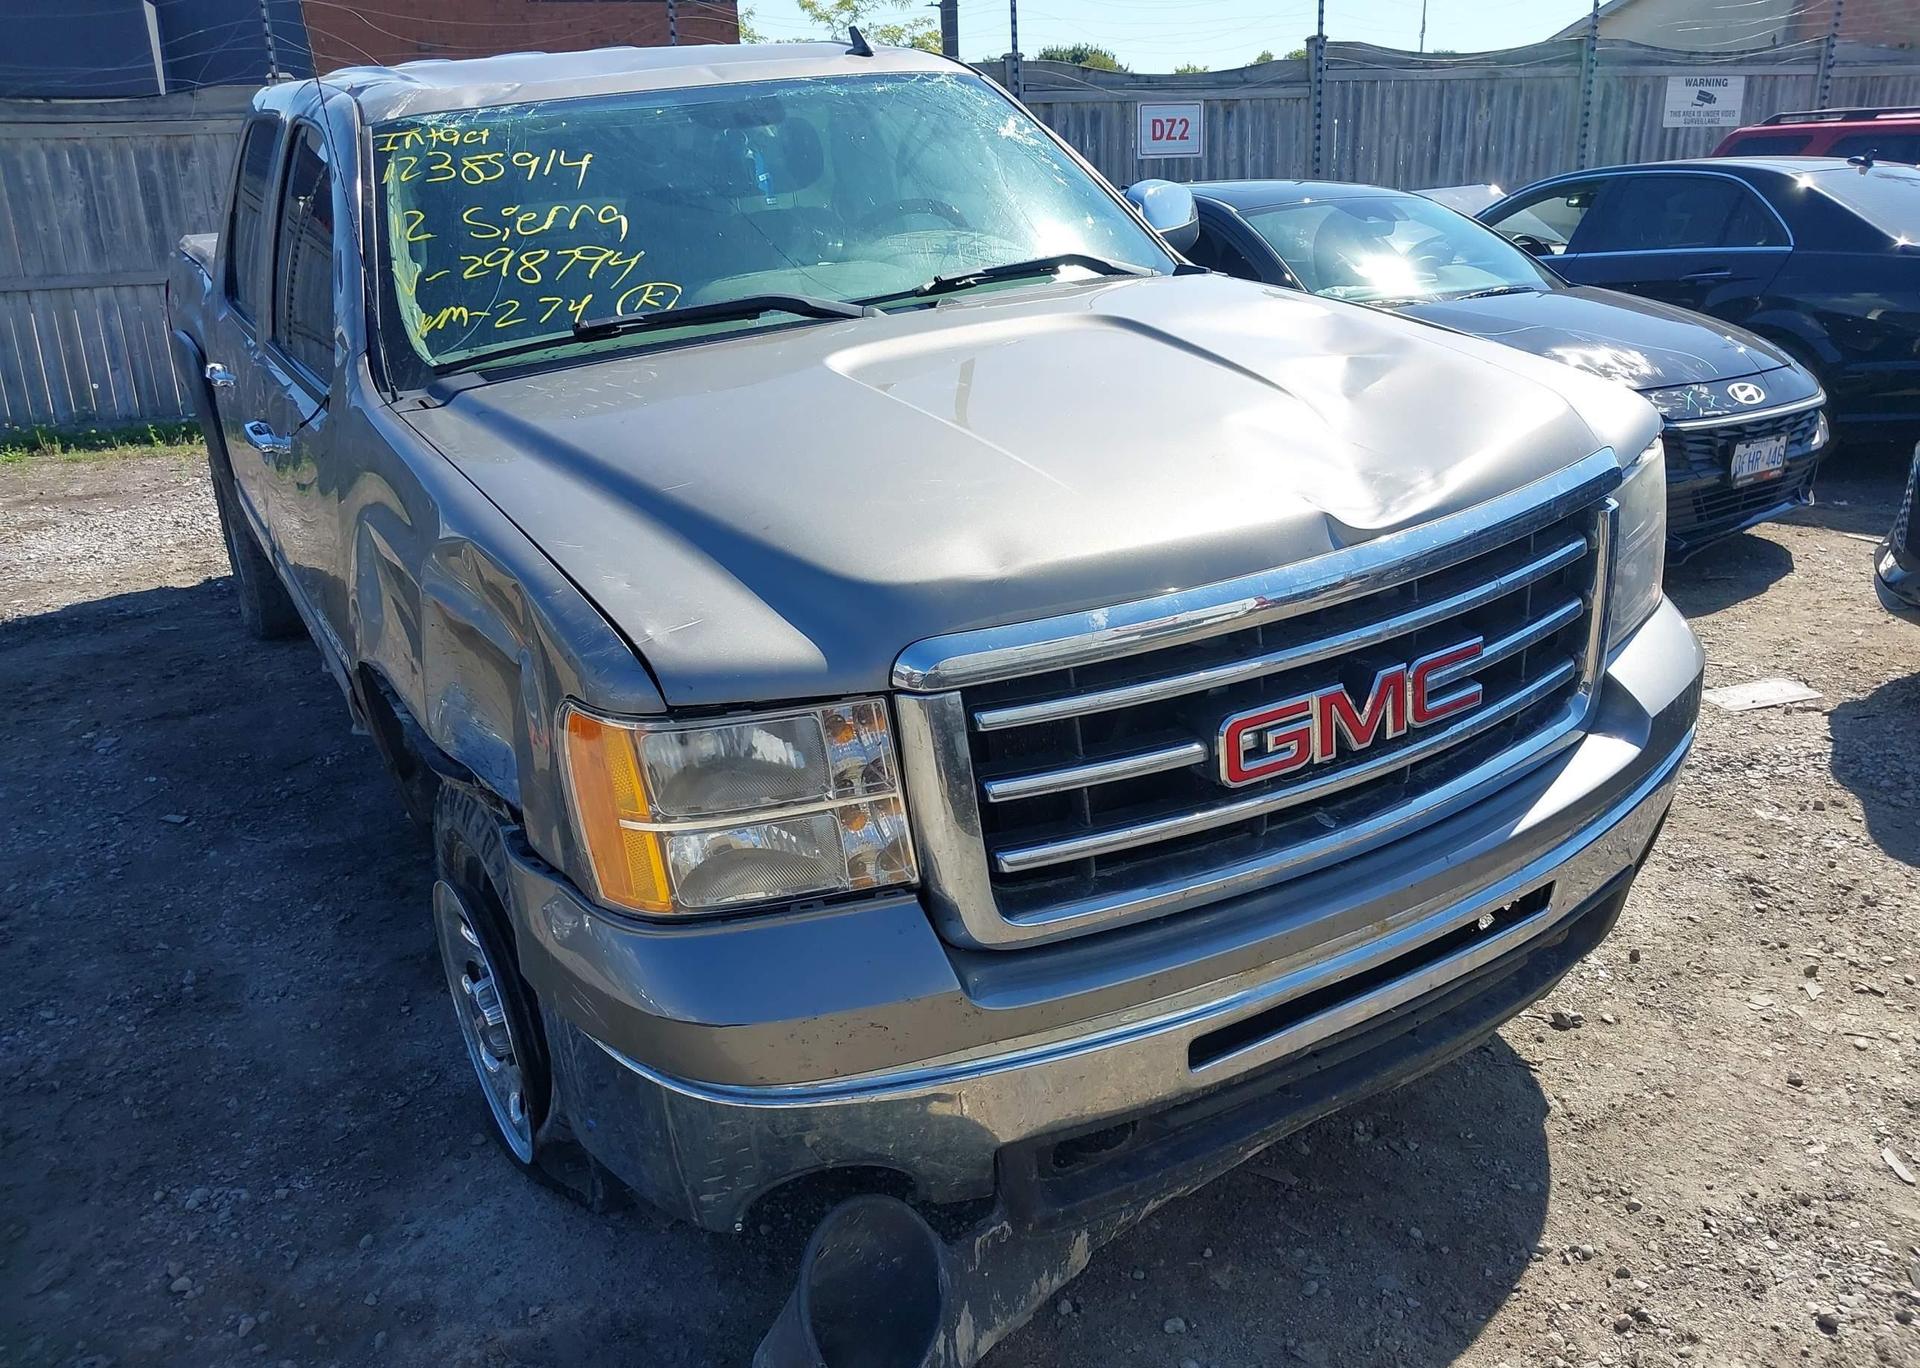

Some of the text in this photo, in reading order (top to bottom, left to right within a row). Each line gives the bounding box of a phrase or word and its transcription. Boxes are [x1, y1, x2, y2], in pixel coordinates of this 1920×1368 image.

[1685, 78, 1728, 87] WARNING
[1151, 118, 1190, 141] DZ2
[462, 204, 629, 242] Sierra
[1219, 636, 1483, 788] GMC
